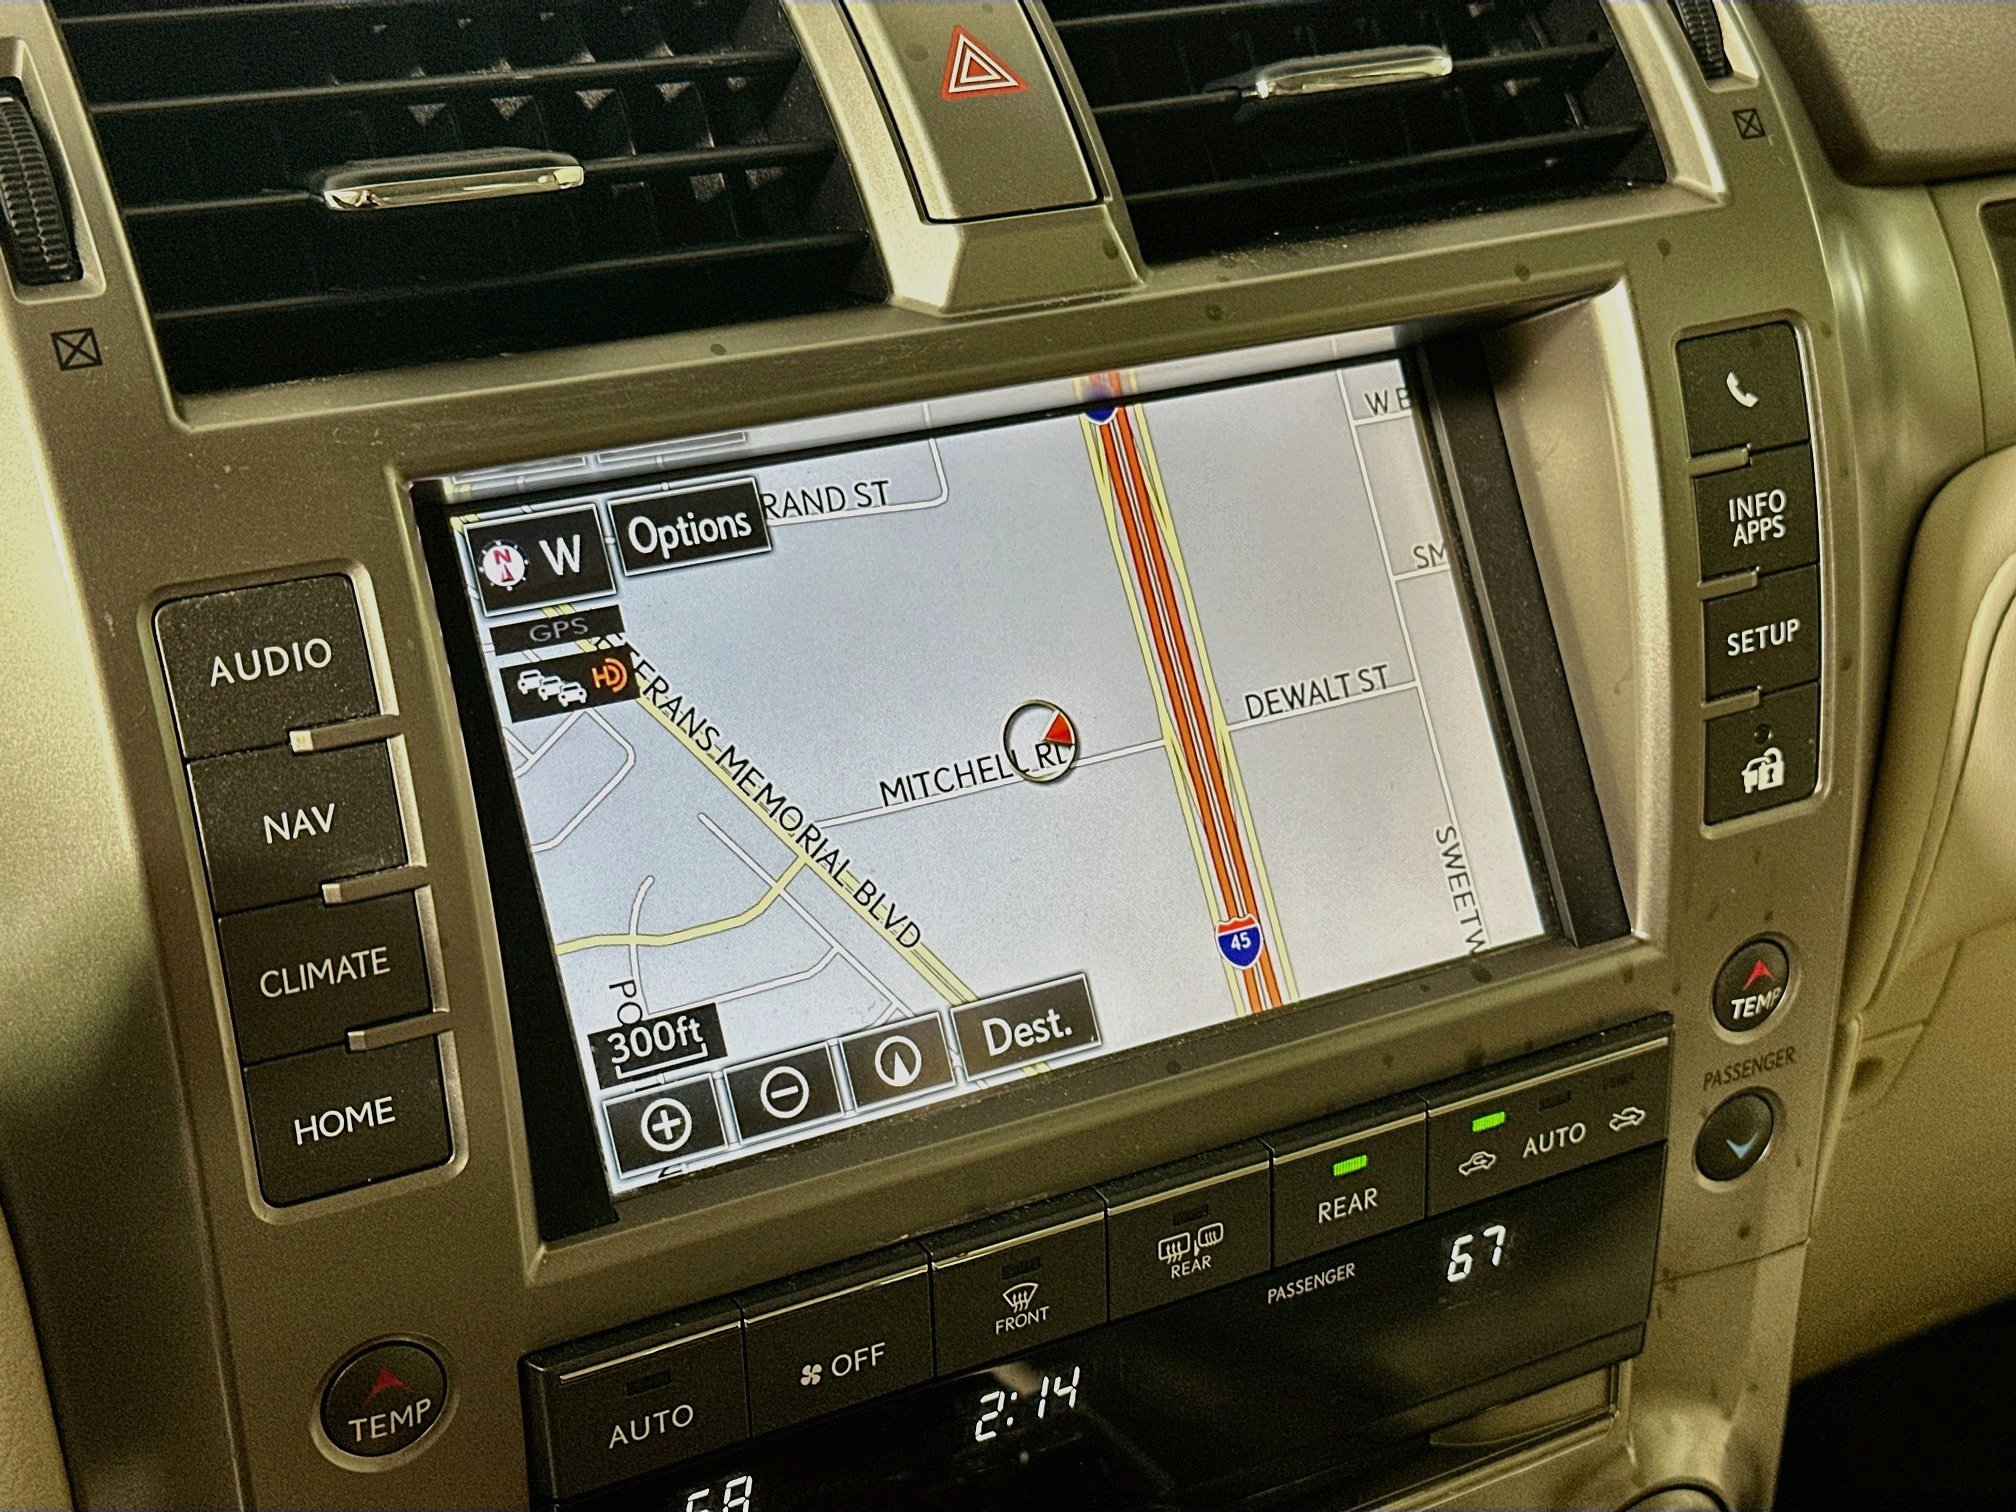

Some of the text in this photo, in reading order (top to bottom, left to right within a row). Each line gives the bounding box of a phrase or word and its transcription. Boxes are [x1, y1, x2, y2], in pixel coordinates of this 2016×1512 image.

[1364, 390, 1388, 416] W
[854, 480, 889, 507] ST
[1728, 489, 1786, 522] INFO
[627, 511, 752, 558] Options
[1733, 515, 1786, 547] APPS
[540, 535, 581, 576] W
[529, 616, 589, 643] GPS
[1727, 619, 1800, 656] SETUP
[210, 638, 332, 687] AUDIO
[1246, 665, 1390, 720] DEWALT ST
[879, 748, 1030, 807] MITCHELL
[263, 803, 336, 844] NAV
[715, 744, 850, 888] MEMORIAL
[852, 879, 921, 949] BLVD
[1230, 932, 1252, 951] 45
[260, 947, 391, 998] CLIMATE
[1731, 986, 1783, 1020] TEMP
[607, 1015, 704, 1064] 300ft
[983, 1008, 1073, 1056] Dest.
[1703, 1046, 1797, 1090] PASSENGER
[294, 1096, 396, 1145] HOME
[1522, 1122, 1586, 1158] AUTO
[1318, 1188, 1378, 1223] REAR
[1170, 1255, 1212, 1279] REAR
[1446, 1225, 1506, 1283] 67
[1267, 1263, 1356, 1304] PASSENGER
[995, 1306, 1050, 1334] FRONT
[831, 1343, 886, 1378] OFF
[348, 1398, 431, 1442] TEMP
[975, 1366, 1080, 1442] 2:14
[608, 1405, 694, 1449] AUTO
